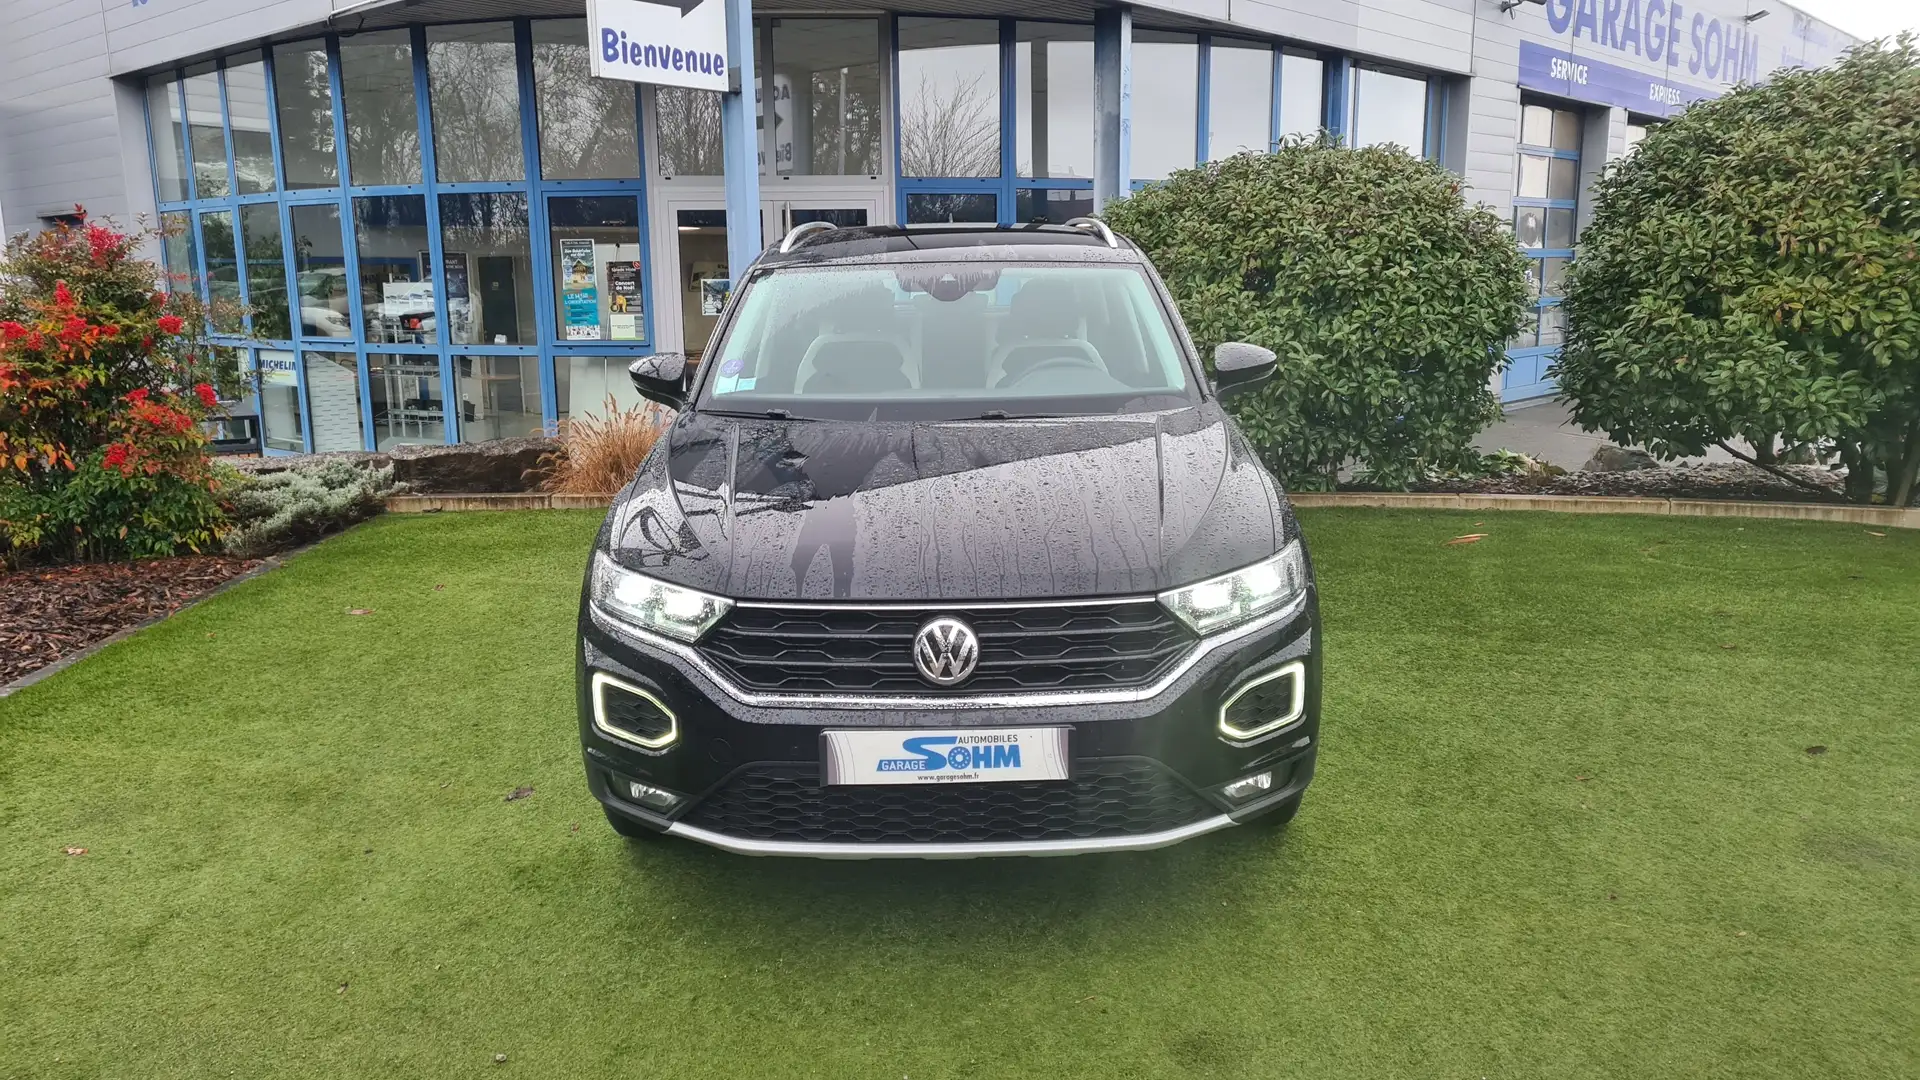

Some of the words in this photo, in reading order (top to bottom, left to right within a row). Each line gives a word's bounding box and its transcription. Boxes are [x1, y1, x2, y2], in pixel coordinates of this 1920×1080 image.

[601, 27, 725, 77] Bienvenue
[1688, 12, 1759, 86] SOHM
[1550, 56, 1588, 85] SERVICE
[1649, 83, 1681, 105] EXPRESS
[260, 359, 296, 371] MICHELIN
[958, 734, 1018, 745] AUTOMOBILES
[902, 736, 1021, 771] SOHM
[881, 760, 926, 771] GARAGE
[917, 772, 979, 782] www.garagesohm.fr
